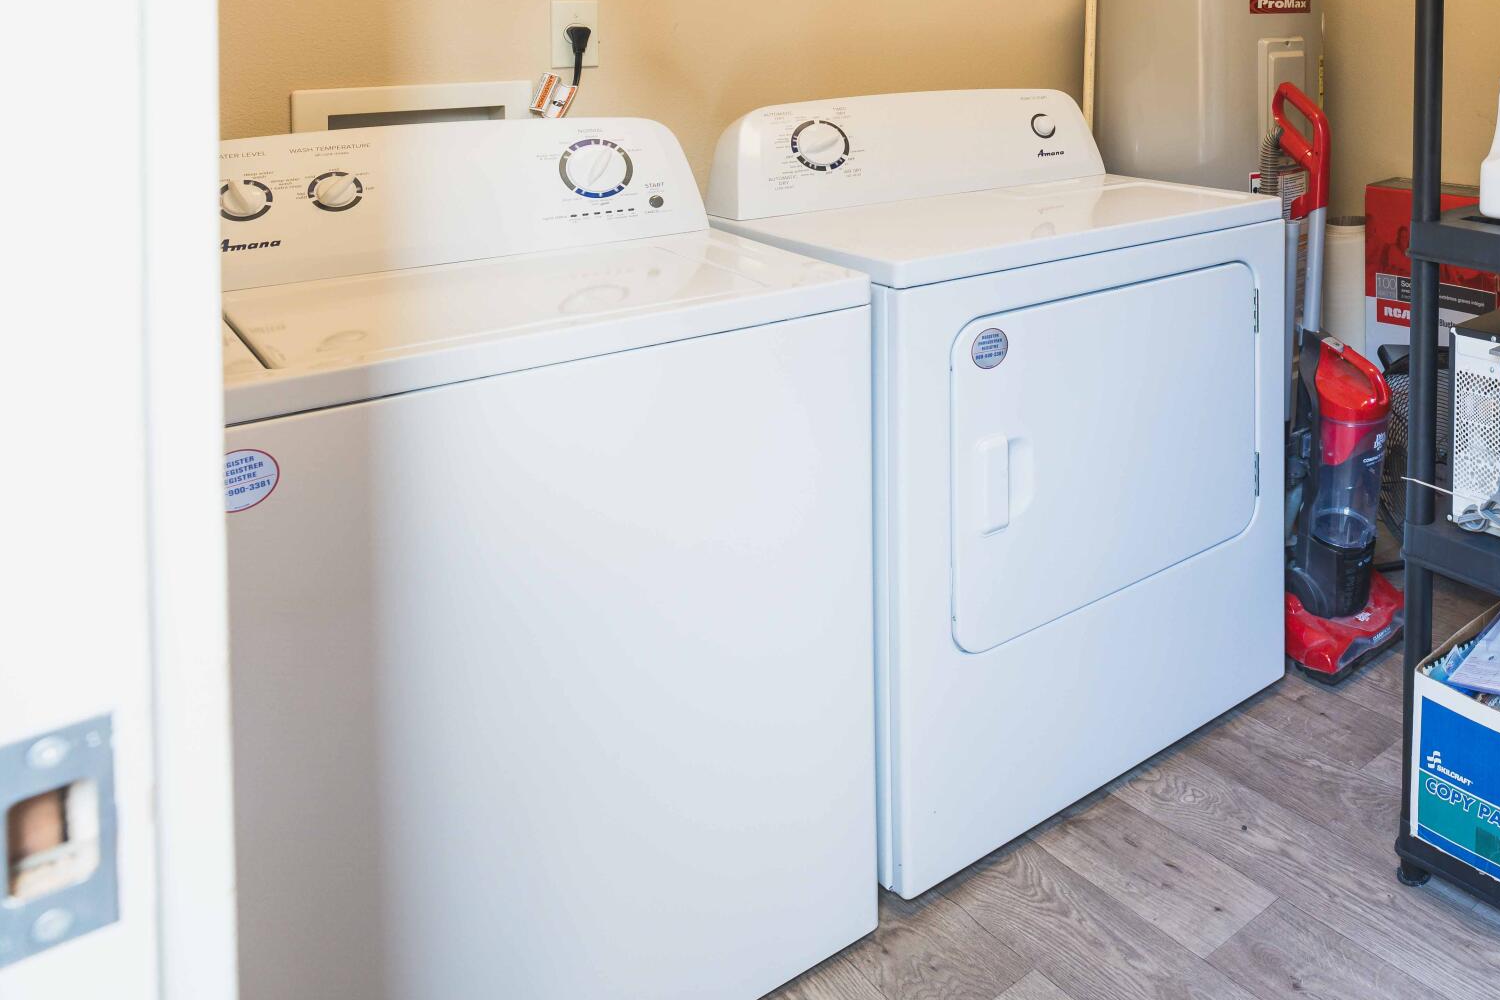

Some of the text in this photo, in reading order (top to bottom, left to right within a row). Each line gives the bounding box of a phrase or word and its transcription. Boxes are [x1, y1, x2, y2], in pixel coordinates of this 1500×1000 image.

[316, 143, 371, 152] TEMPERATURE
[1038, 149, 1064, 158] Amana
[221, 239, 281, 252] Amana
[226, 456, 254, 468] GISTER
[224, 471, 257, 485] EGISTRE
[1437, 764, 1472, 786] SKILCRAFT
[1425, 777, 1475, 812] COPY
